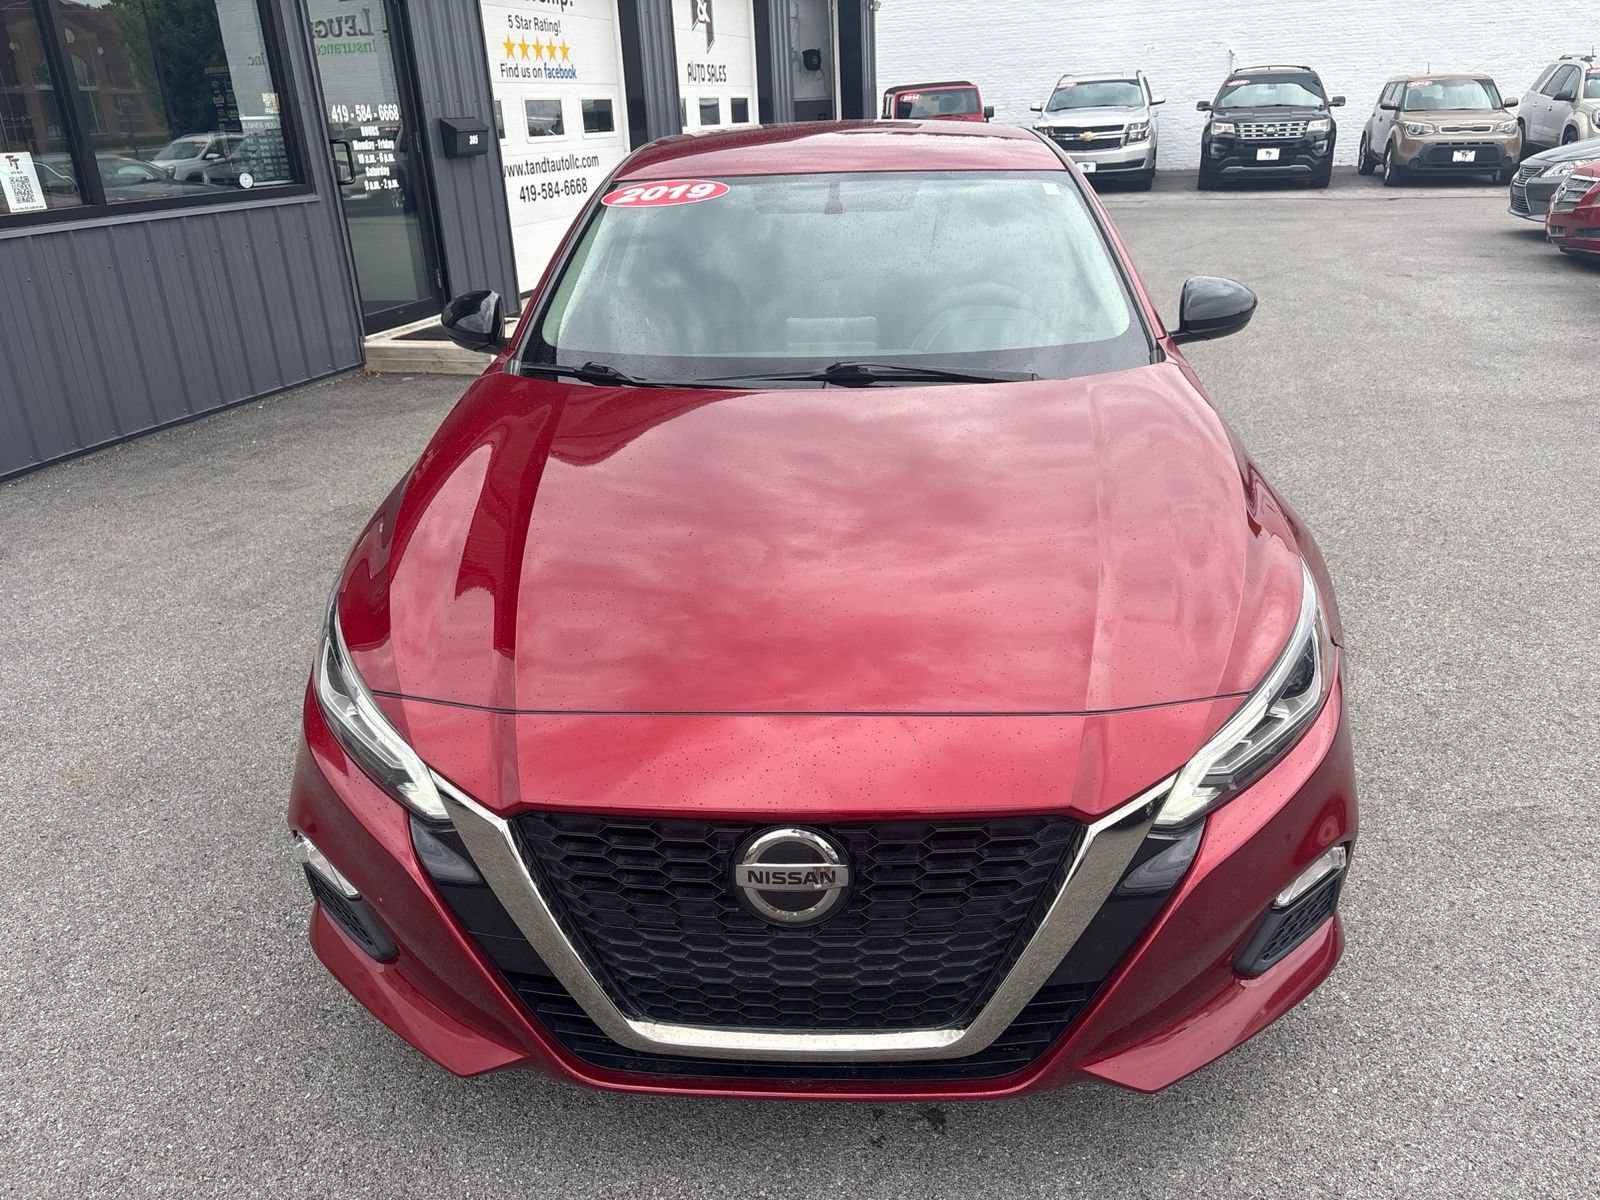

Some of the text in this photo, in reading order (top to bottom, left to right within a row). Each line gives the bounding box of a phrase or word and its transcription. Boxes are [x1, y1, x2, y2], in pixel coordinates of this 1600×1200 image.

[508, 15, 561, 36] 5 Star Rating!
[500, 62, 577, 79] Find us on facebook
[687, 61, 727, 84] AUTO SALES
[352, 140, 375, 150] Monday
[377, 139, 395, 150] Friday
[519, 177, 588, 203] 419-584-6668
[612, 183, 716, 204] 2019
[747, 870, 836, 885] NISSAN
